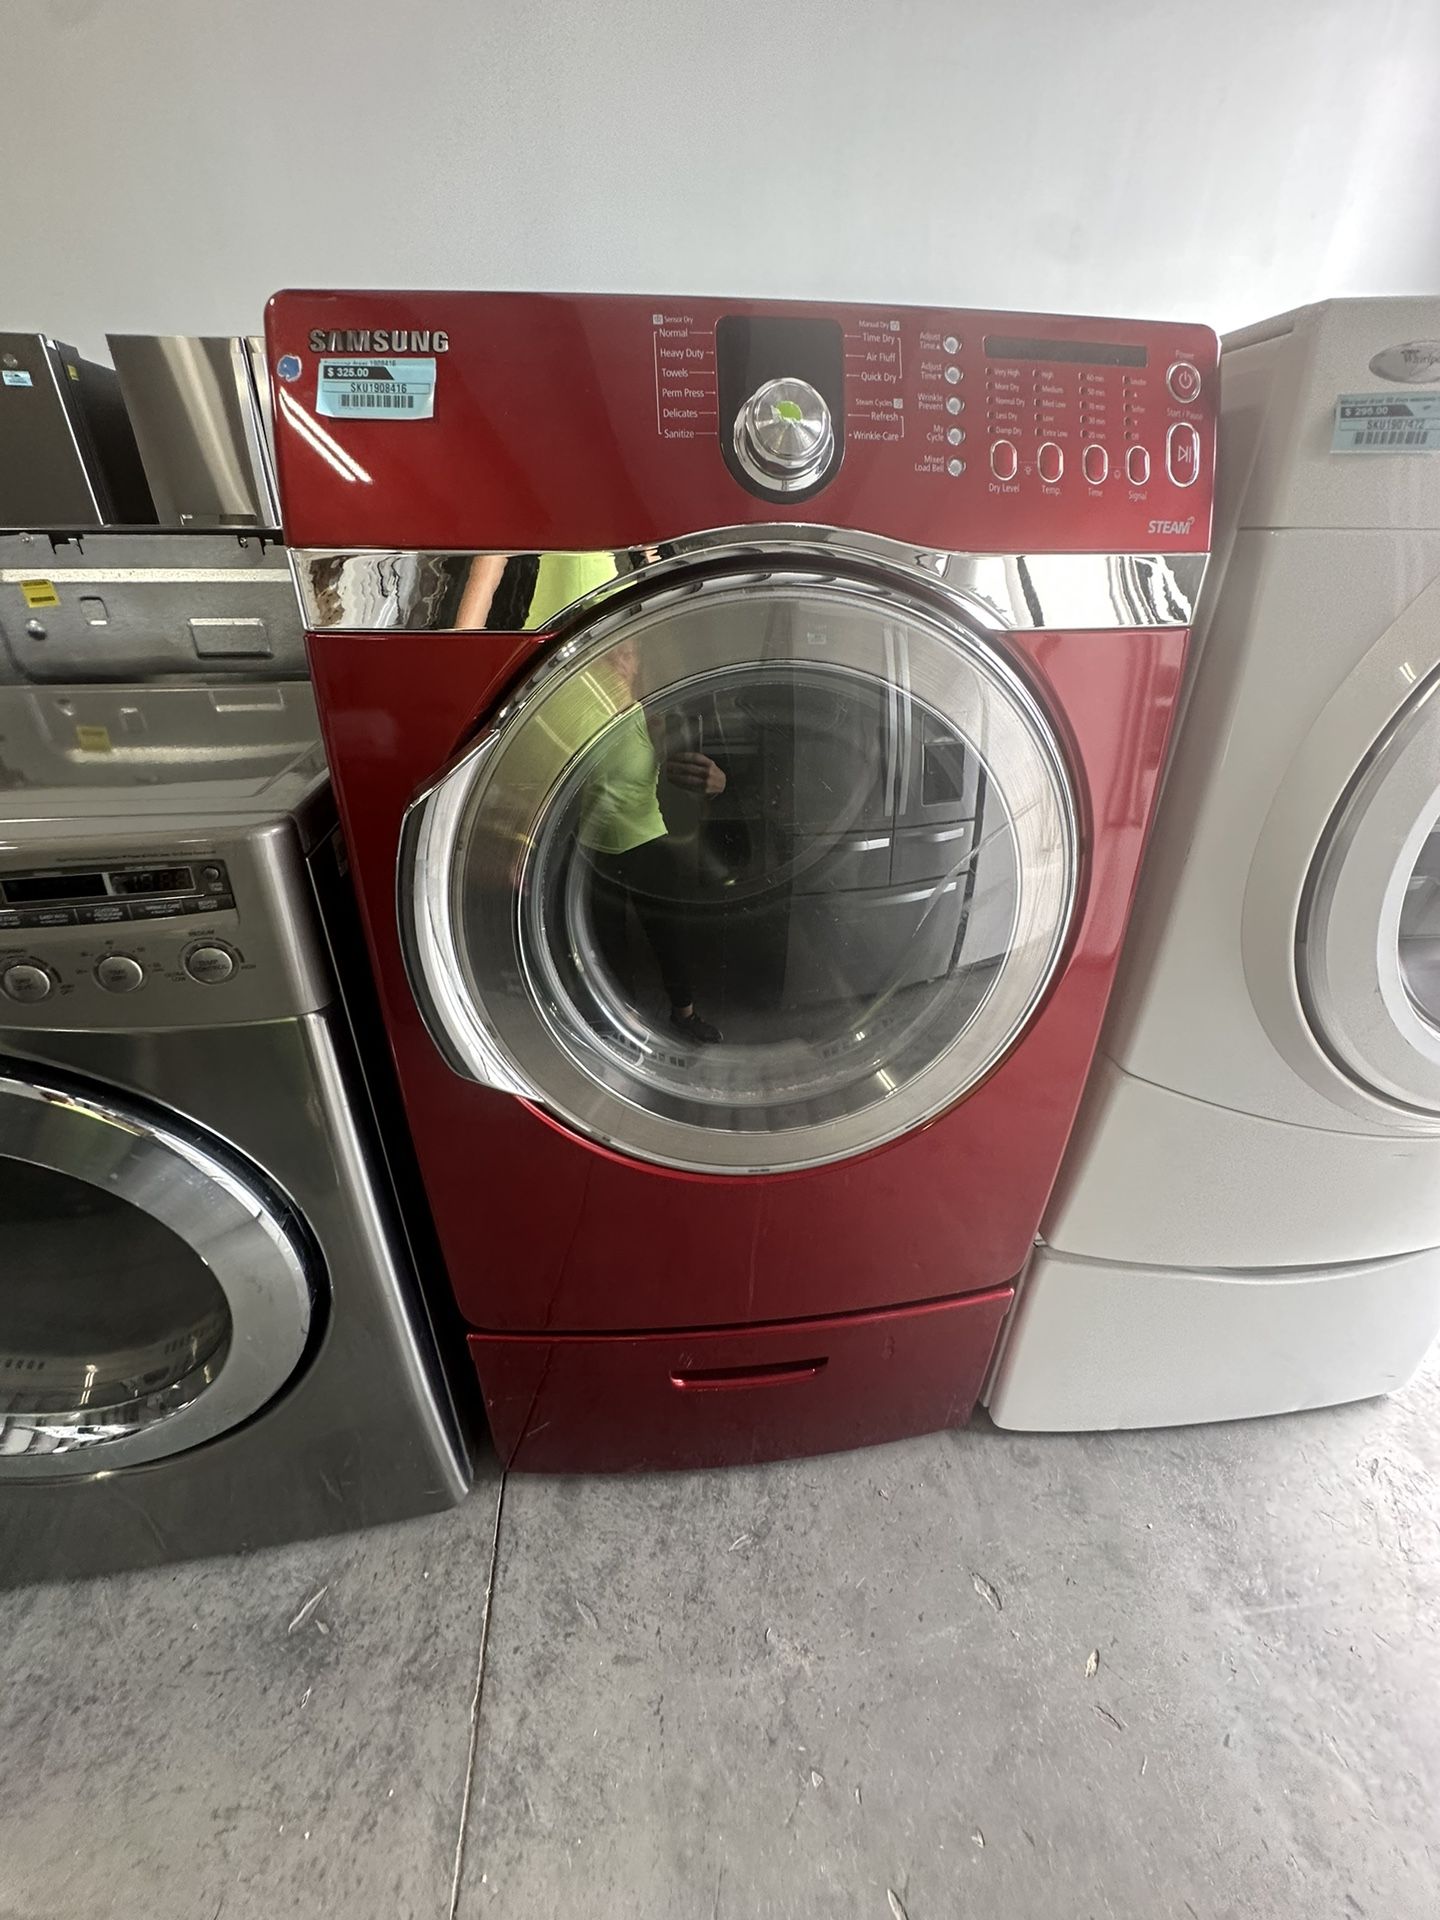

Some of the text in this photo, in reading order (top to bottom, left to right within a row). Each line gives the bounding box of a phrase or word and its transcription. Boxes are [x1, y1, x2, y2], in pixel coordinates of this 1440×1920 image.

[664, 315, 693, 327] Sensor Dry
[859, 320, 890, 331] Manual Dry
[659, 328, 688, 338] Normal
[919, 332, 941, 342] Adjust
[309, 329, 449, 353] SAMSUNG
[863, 333, 896, 345] Time Dry
[920, 341, 936, 350] Time
[660, 348, 705, 360] Heavy Duty
[866, 352, 896, 362] Air Fluff
[1175, 350, 1195, 360] Power
[920, 362, 942, 372] Adjust
[327, 368, 369, 378] $ 325.00
[662, 368, 688, 378] Towels
[861, 371, 897, 384] Quick Dry
[921, 371, 937, 380] Time
[350, 383, 408, 394] SKU1908416
[662, 388, 705, 398] Perm Press
[917, 393, 943, 402] Wrinkle
[856, 398, 893, 408] Steam Cycles
[918, 401, 943, 411] Prevent
[663, 408, 699, 418] Delicates
[871, 411, 899, 421] Refresh
[1167, 407, 1181, 417] Start
[1186, 410, 1203, 420] Pause
[664, 428, 695, 439] Sanitize
[933, 424, 944, 434] My
[853, 430, 899, 442] Wrinkle Care
[926, 432, 944, 443] Cycle
[924, 455, 944, 464] Mixed
[914, 463, 945, 473] Load Bell
[988, 483, 1020, 495] Dry Level
[1041, 485, 1062, 496] Temp.
[1087, 487, 1103, 497] Time
[1129, 490, 1147, 502] Signal
[1147, 518, 1192, 535] STEAM
